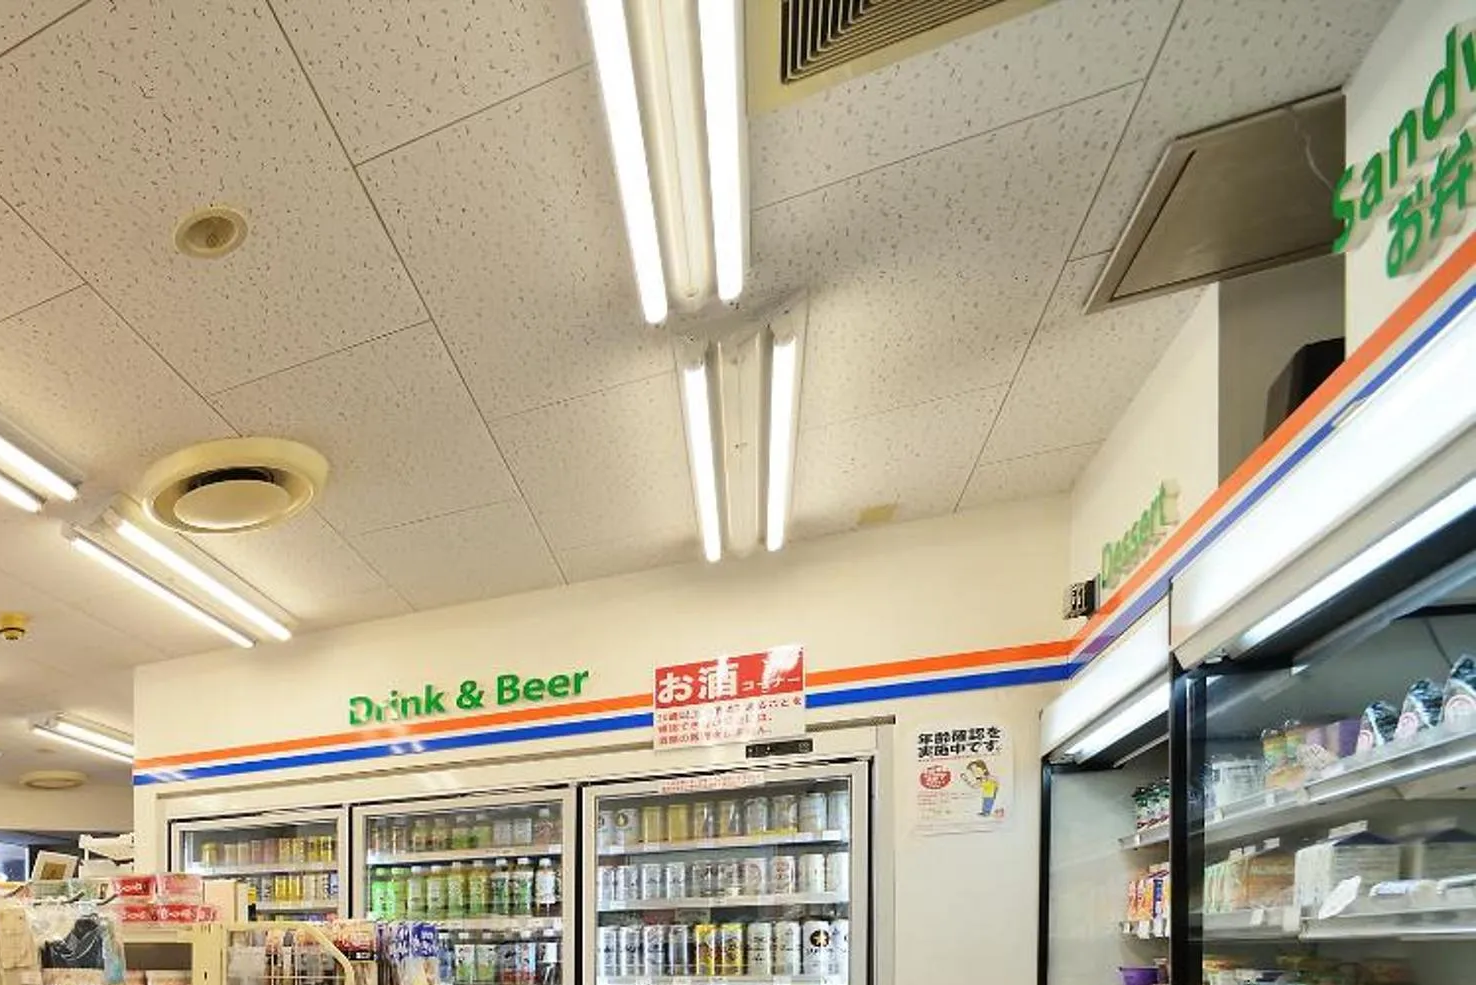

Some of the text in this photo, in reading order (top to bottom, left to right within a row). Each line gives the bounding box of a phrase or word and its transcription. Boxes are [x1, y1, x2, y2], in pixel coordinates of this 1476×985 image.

[349, 670, 590, 725] Drink & Beer
